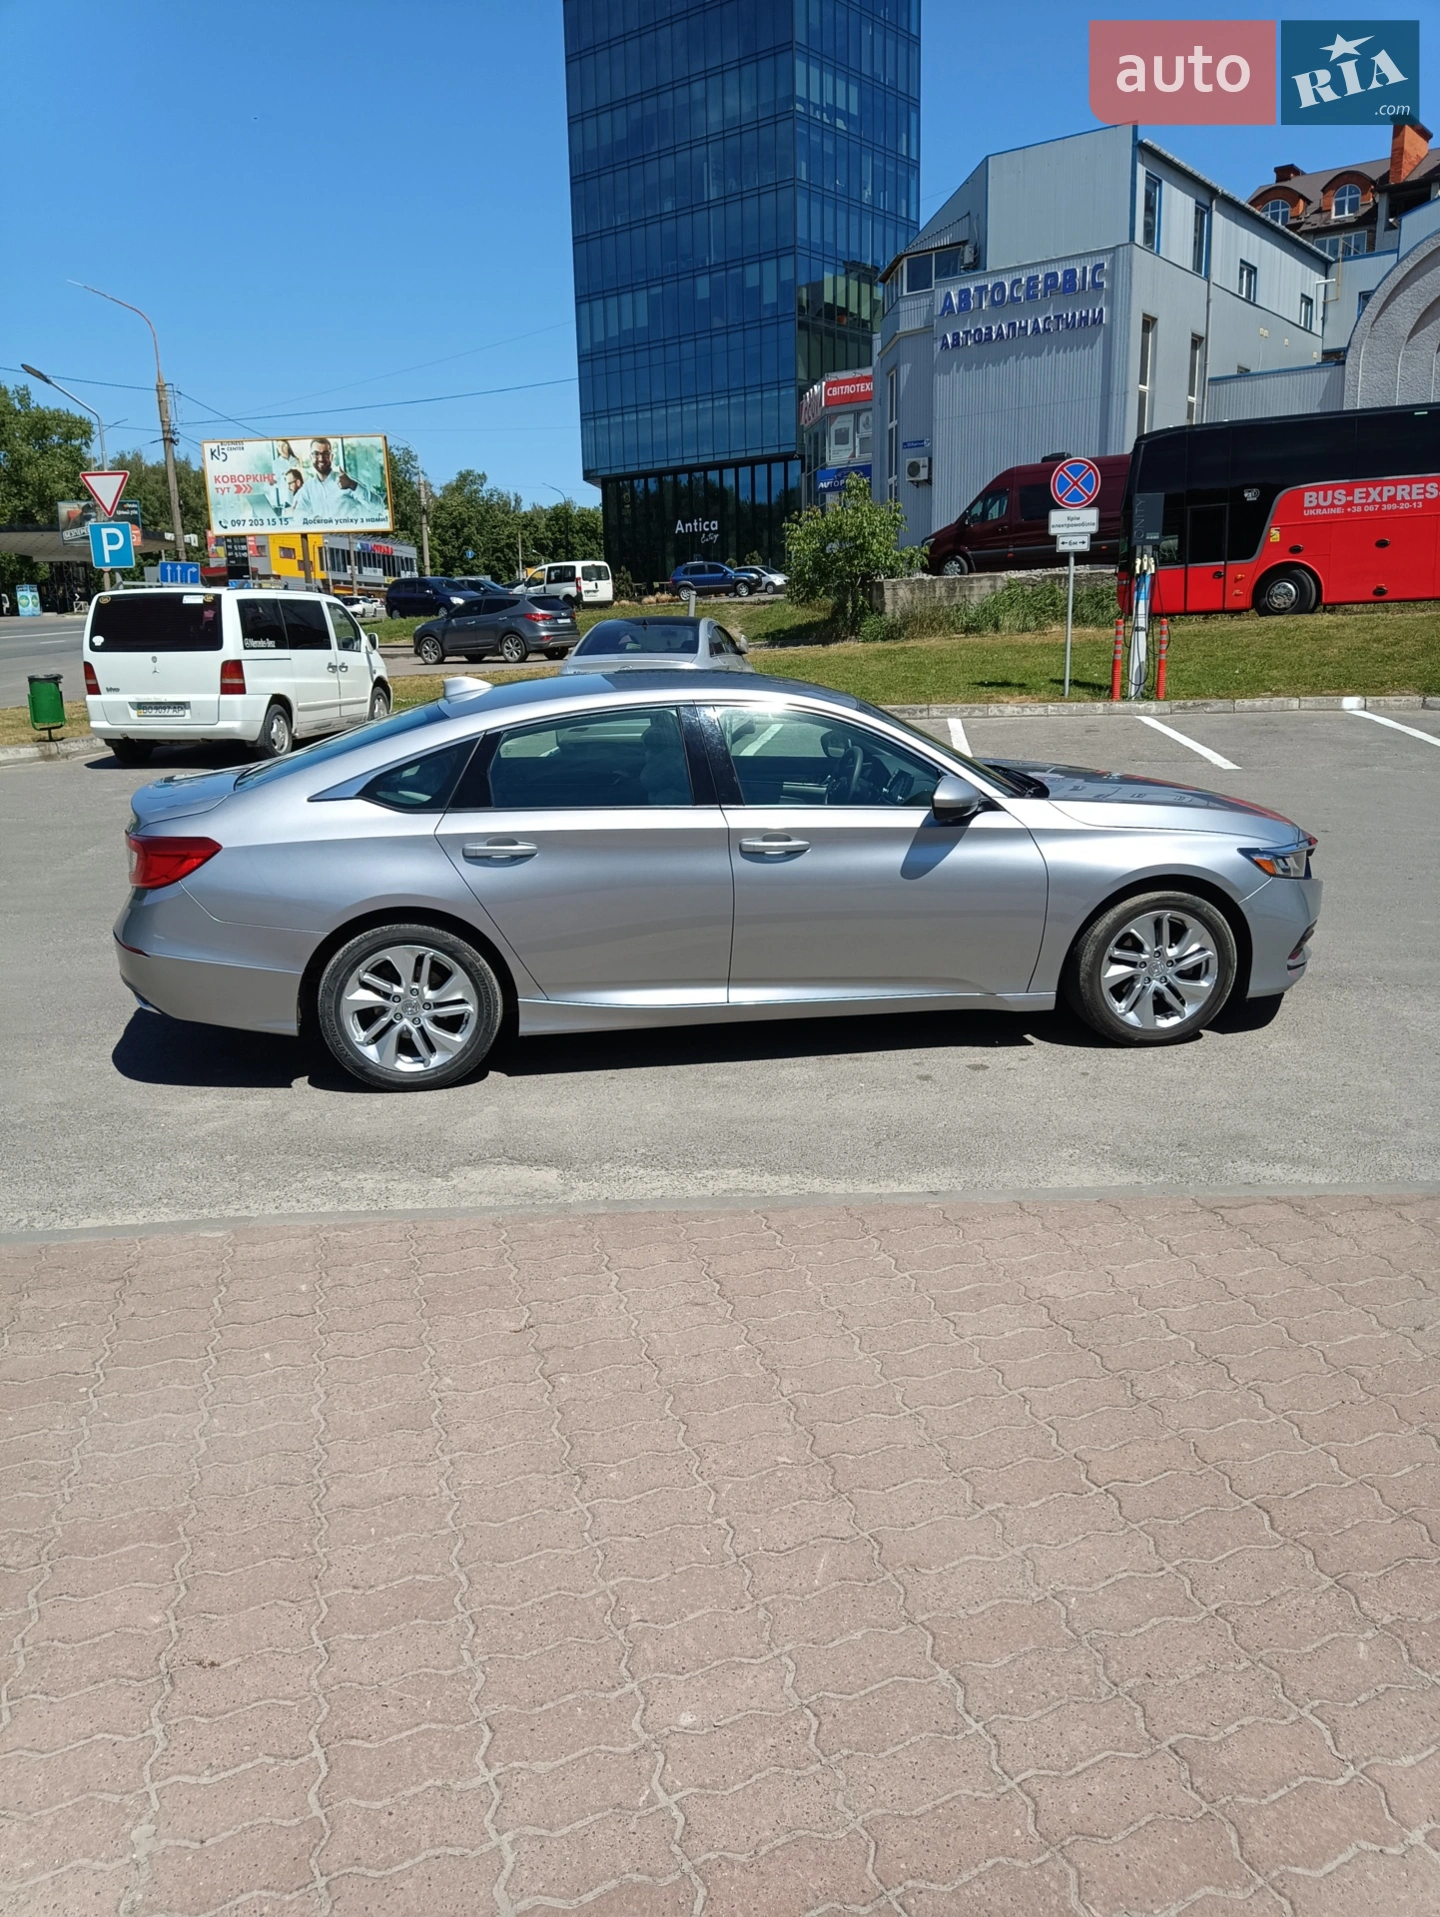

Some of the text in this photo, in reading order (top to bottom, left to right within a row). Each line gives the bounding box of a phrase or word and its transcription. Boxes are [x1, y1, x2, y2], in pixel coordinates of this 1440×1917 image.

[940, 262, 1107, 317] АВТОСЕРВІС
[940, 306, 1106, 351] АВТОЗАПЧАСТИНИ
[214, 474, 275, 484] КОВОРКІНГ
[1303, 482, 1440, 508] BUS-EXPRES
[1303, 501, 1423, 516] UKRAINE: +38 067 399-20-13
[231, 518, 290, 527] 097 203 15 15
[335, 517, 358, 525] успіху
[675, 518, 718, 534] Antica
[101, 528, 124, 563] P
[154, 705, 171, 715] 9097
